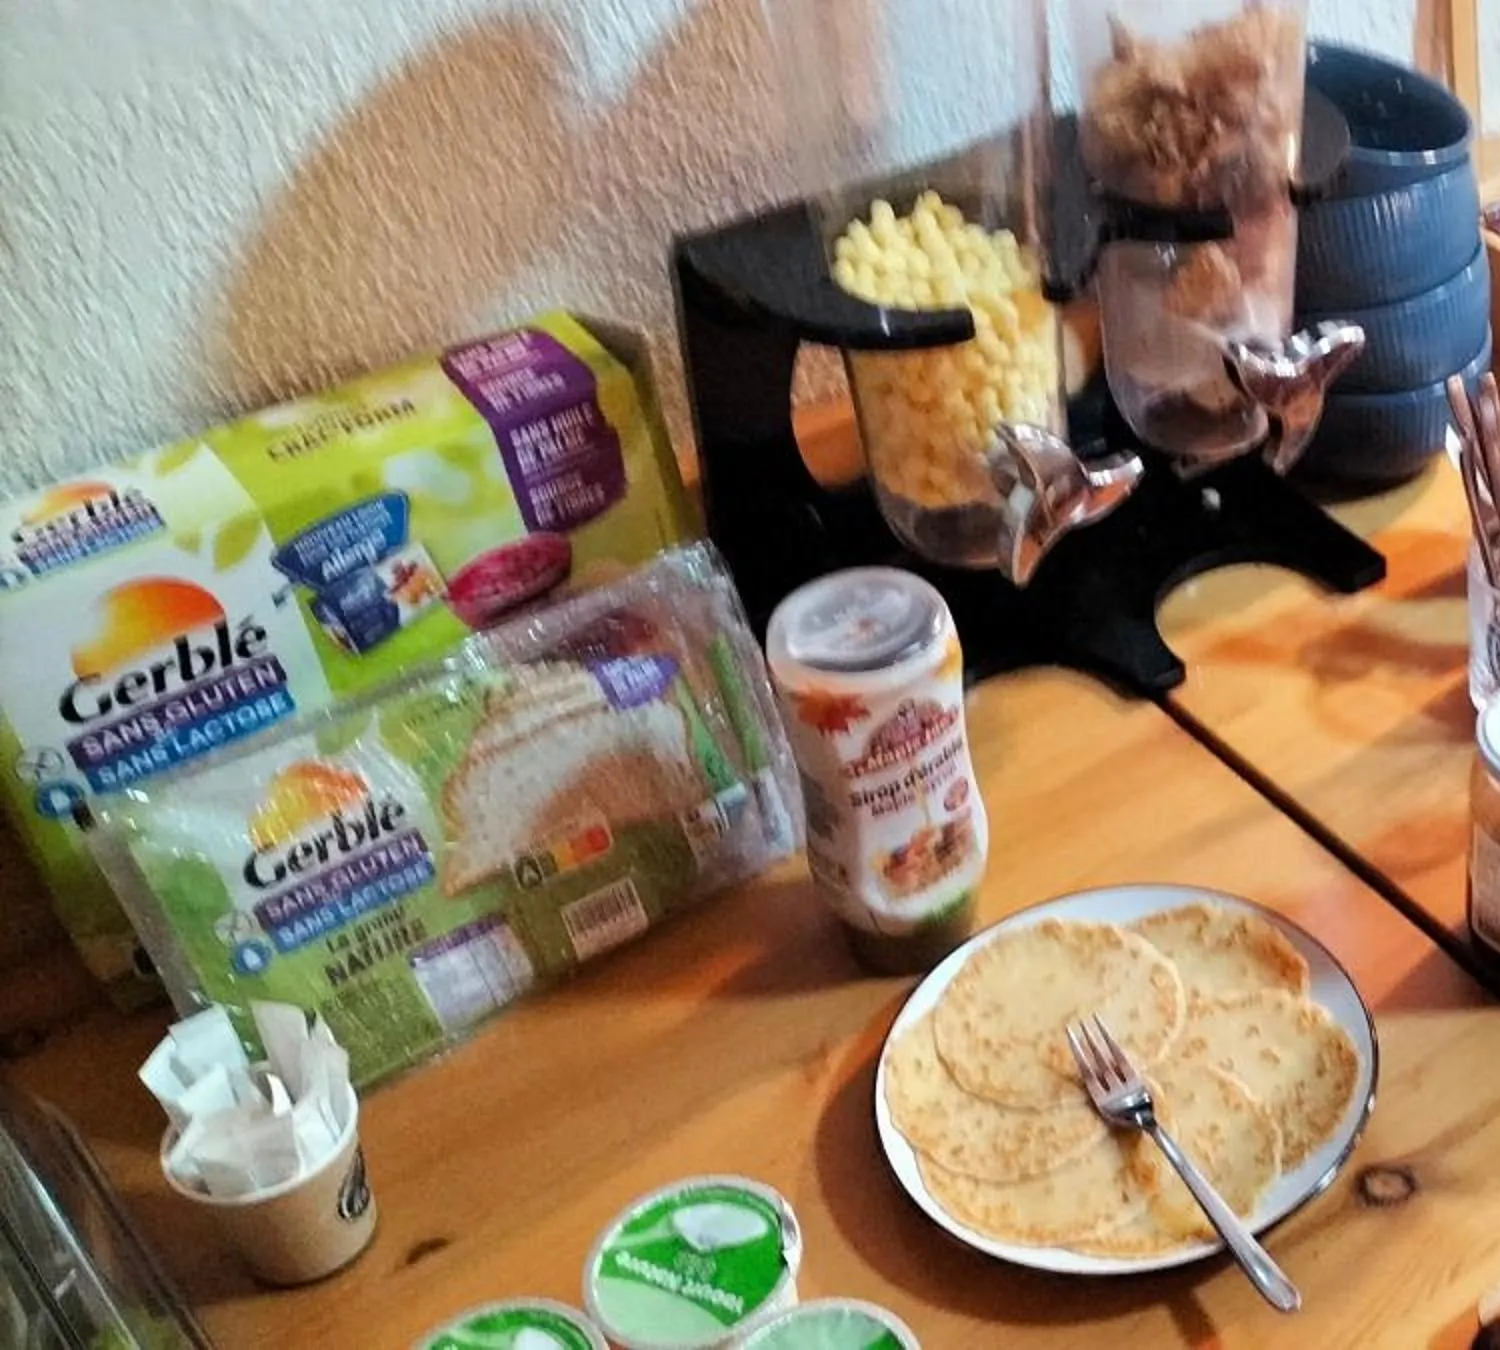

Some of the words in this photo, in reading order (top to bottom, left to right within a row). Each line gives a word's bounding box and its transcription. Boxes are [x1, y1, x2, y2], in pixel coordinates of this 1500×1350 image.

[58, 614, 268, 723] Gerblé
[81, 710, 164, 759] SANS
[165, 661, 281, 728] GLUTEN
[97, 743, 170, 785] SANS
[172, 691, 288, 754] LACTOSE
[243, 791, 406, 888] Gerblé
[265, 883, 327, 921] SANS
[330, 833, 426, 898] GLUTEN
[276, 904, 336, 948] SANS
[337, 858, 432, 919] LACTOSE
